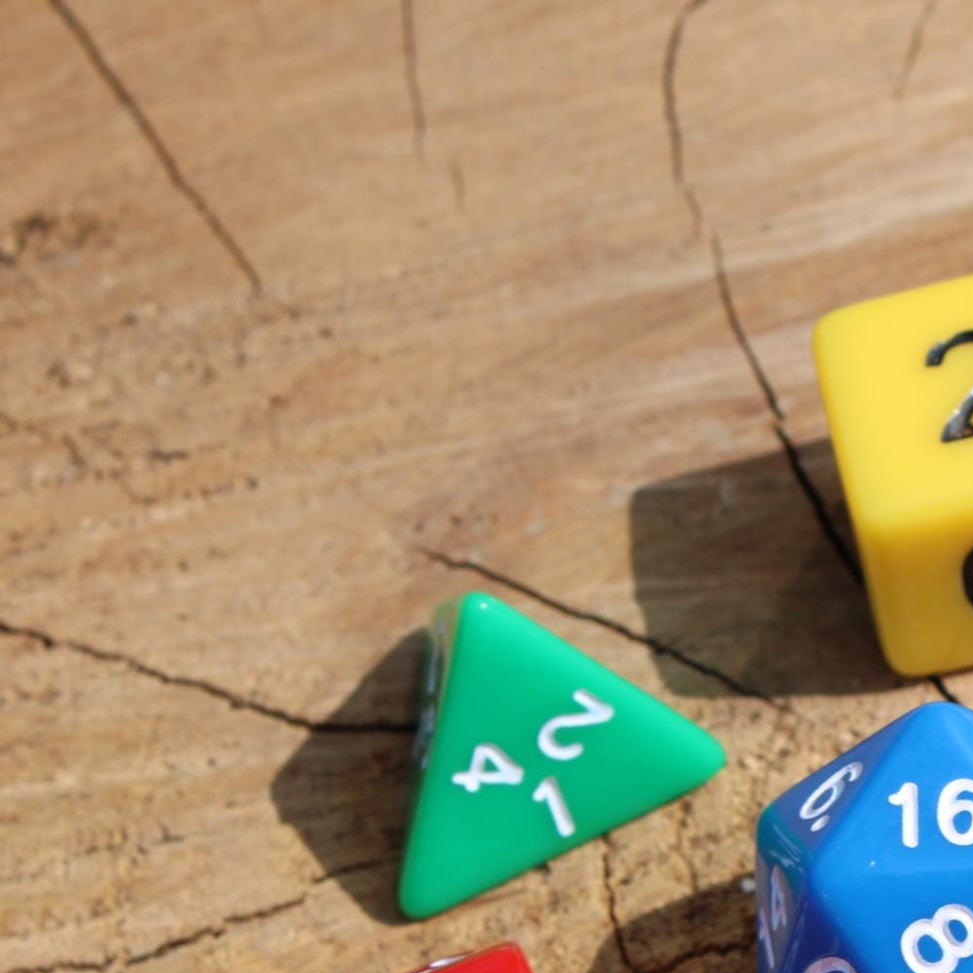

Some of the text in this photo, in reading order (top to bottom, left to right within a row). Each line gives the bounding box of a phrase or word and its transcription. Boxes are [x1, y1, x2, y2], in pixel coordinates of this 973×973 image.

[538, 689, 614, 761] 2
[452, 744, 524, 793] 4
[532, 776, 575, 838] 1
